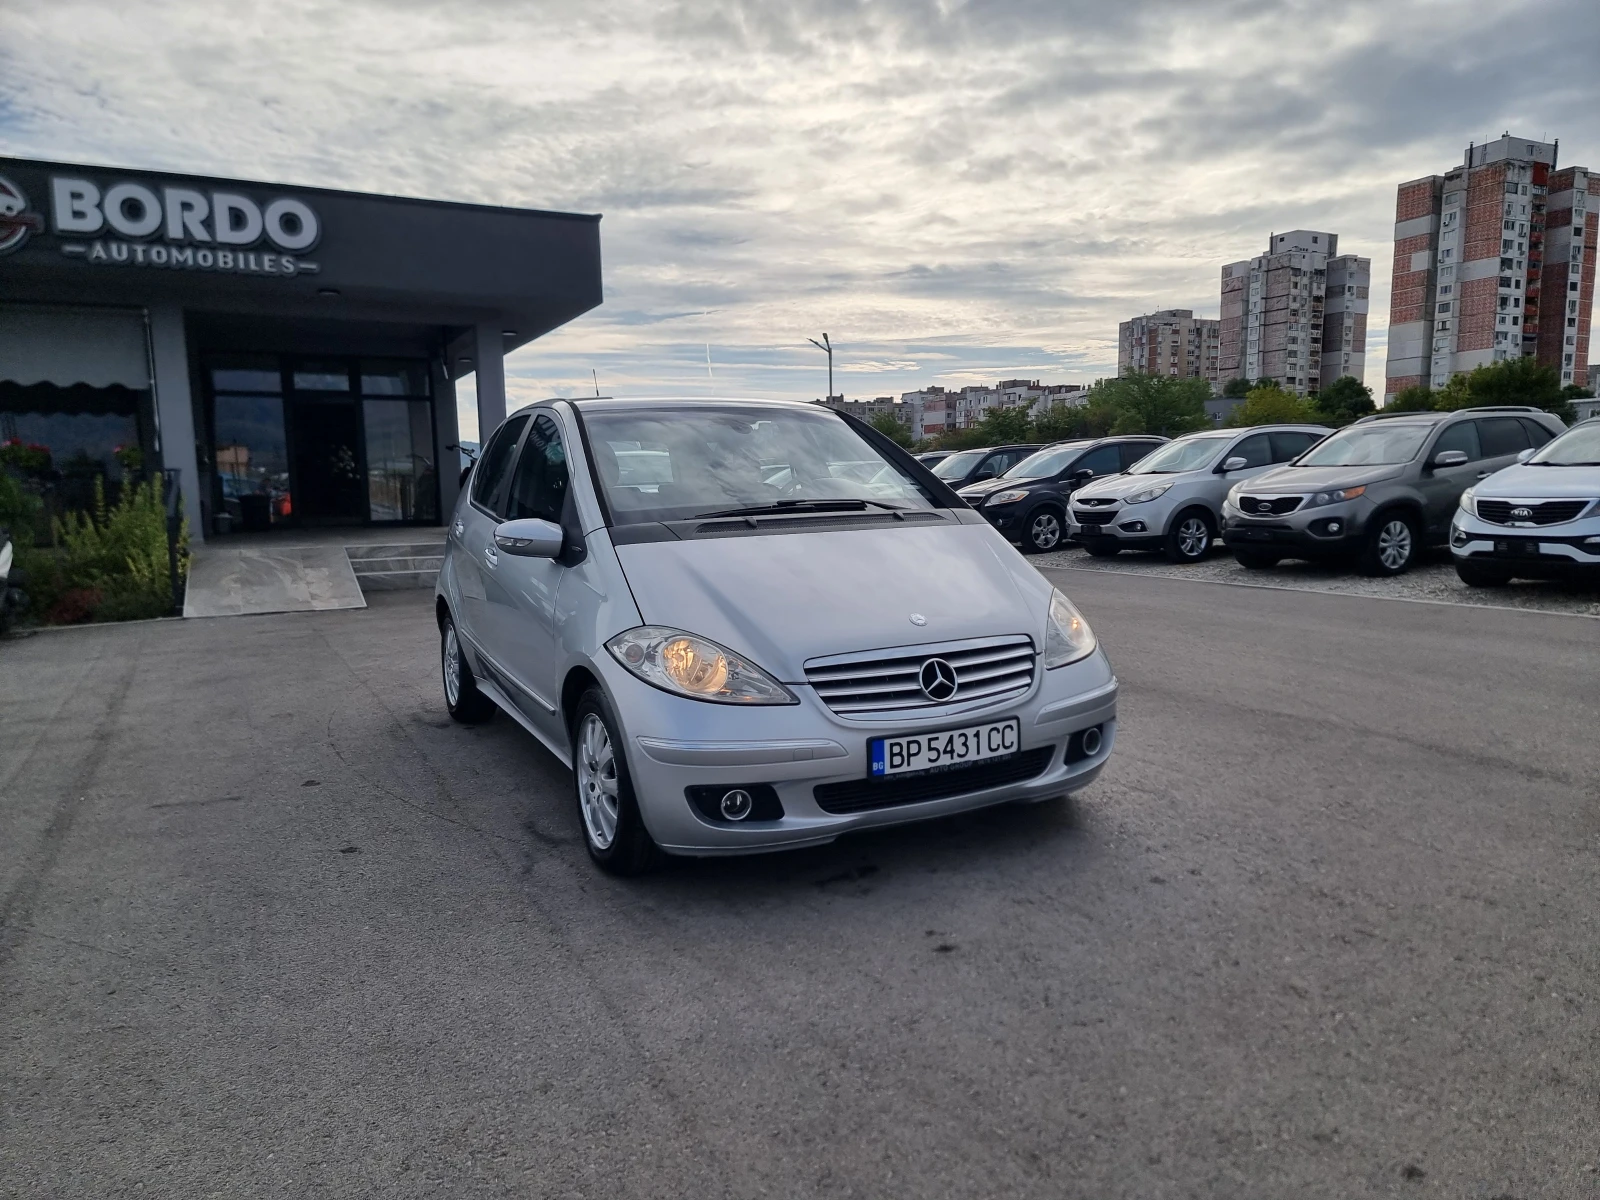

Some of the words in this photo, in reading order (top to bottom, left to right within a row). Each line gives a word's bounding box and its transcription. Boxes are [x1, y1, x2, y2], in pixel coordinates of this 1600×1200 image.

[52, 177, 318, 249] BORDO
[91, 244, 295, 273] AUTOMOBILES
[889, 740, 921, 769] BP
[927, 730, 981, 763] 5431
[988, 724, 1014, 753] CC
[872, 762, 884, 771] BG
[930, 765, 949, 773] AUTO
